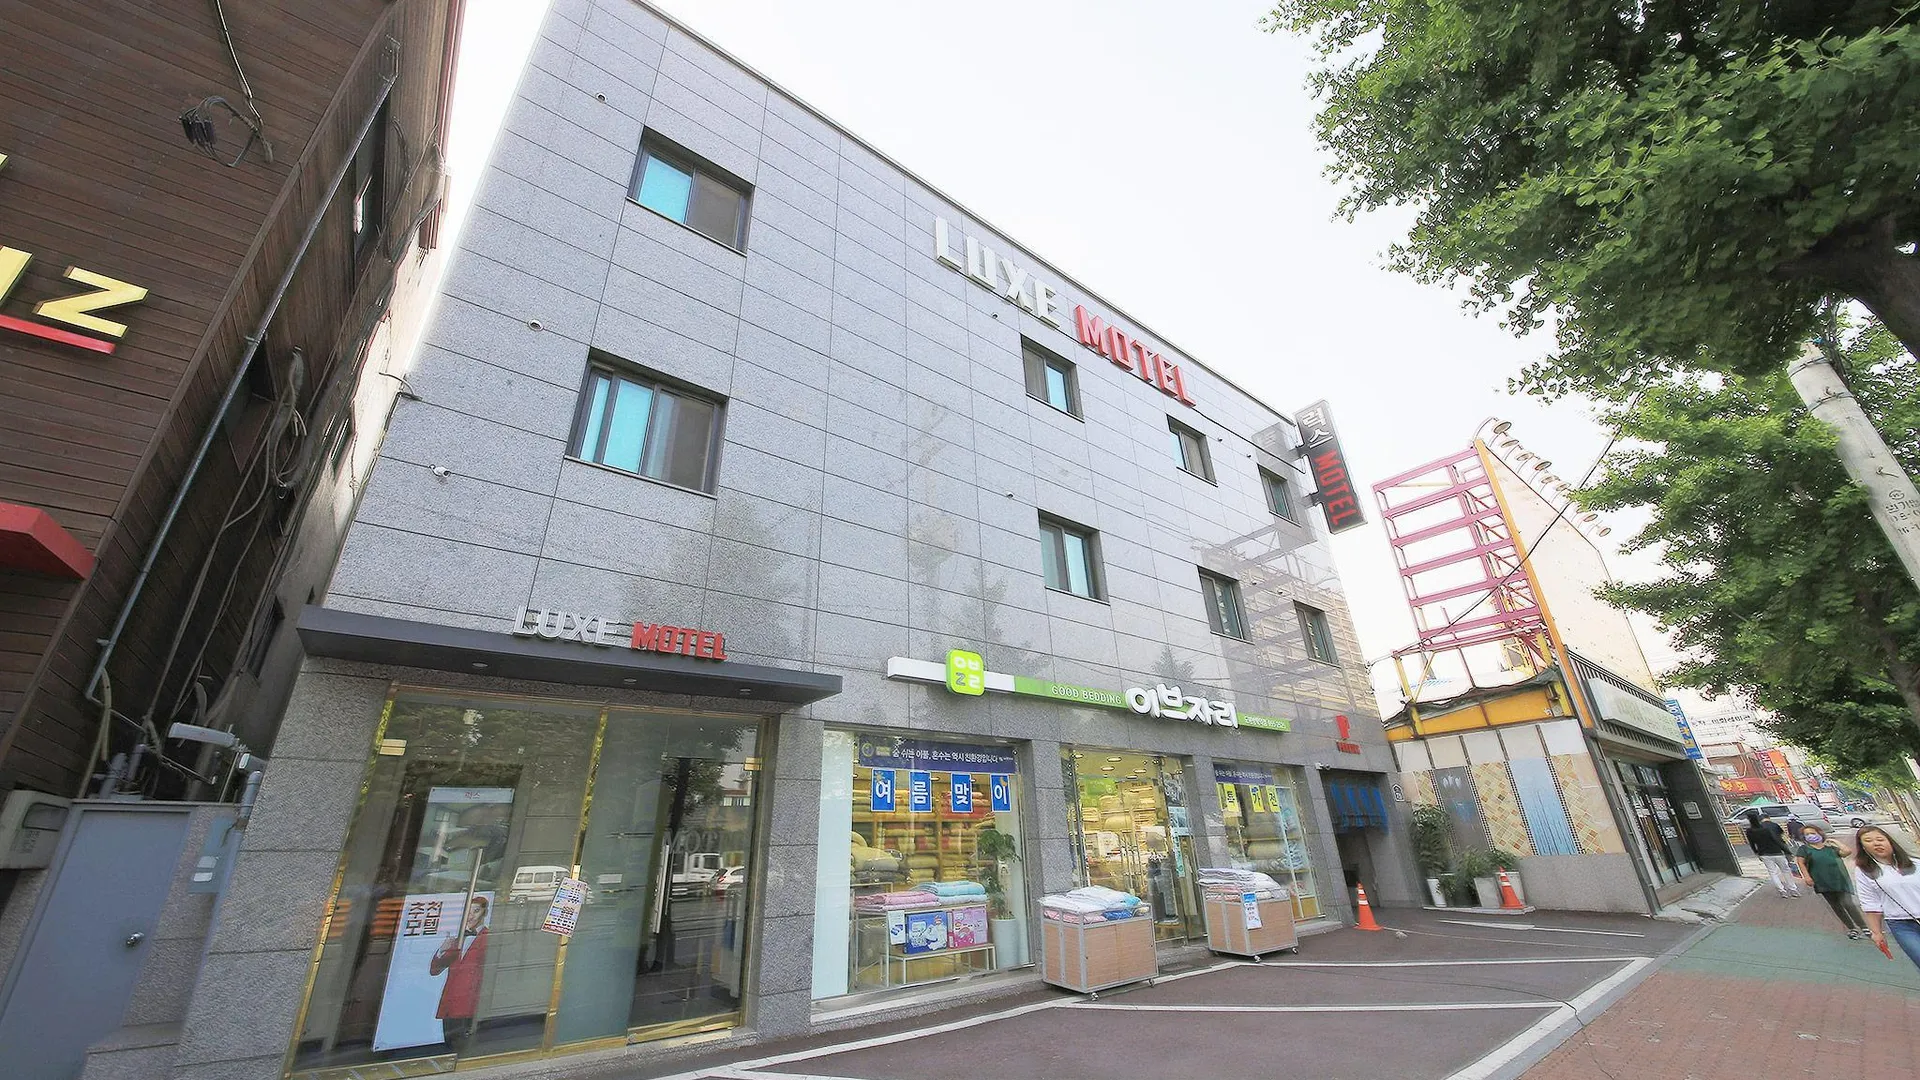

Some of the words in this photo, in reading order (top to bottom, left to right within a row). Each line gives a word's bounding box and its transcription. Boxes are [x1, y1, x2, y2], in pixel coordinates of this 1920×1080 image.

[935, 216, 1060, 330] LUXE
[1075, 304, 1197, 408] MOTEL
[1301, 407, 1334, 449] 럭스
[1315, 449, 1358, 526] MOTEL
[511, 604, 619, 646] LUXE
[630, 620, 728, 661] MOTEL
[1051, 685, 1080, 699] GOOD
[1082, 689, 1123, 706] BEDDING
[1125, 683, 1239, 730] 이브자리
[403, 917, 441, 938] 모텔
[408, 900, 444, 919] 추천
